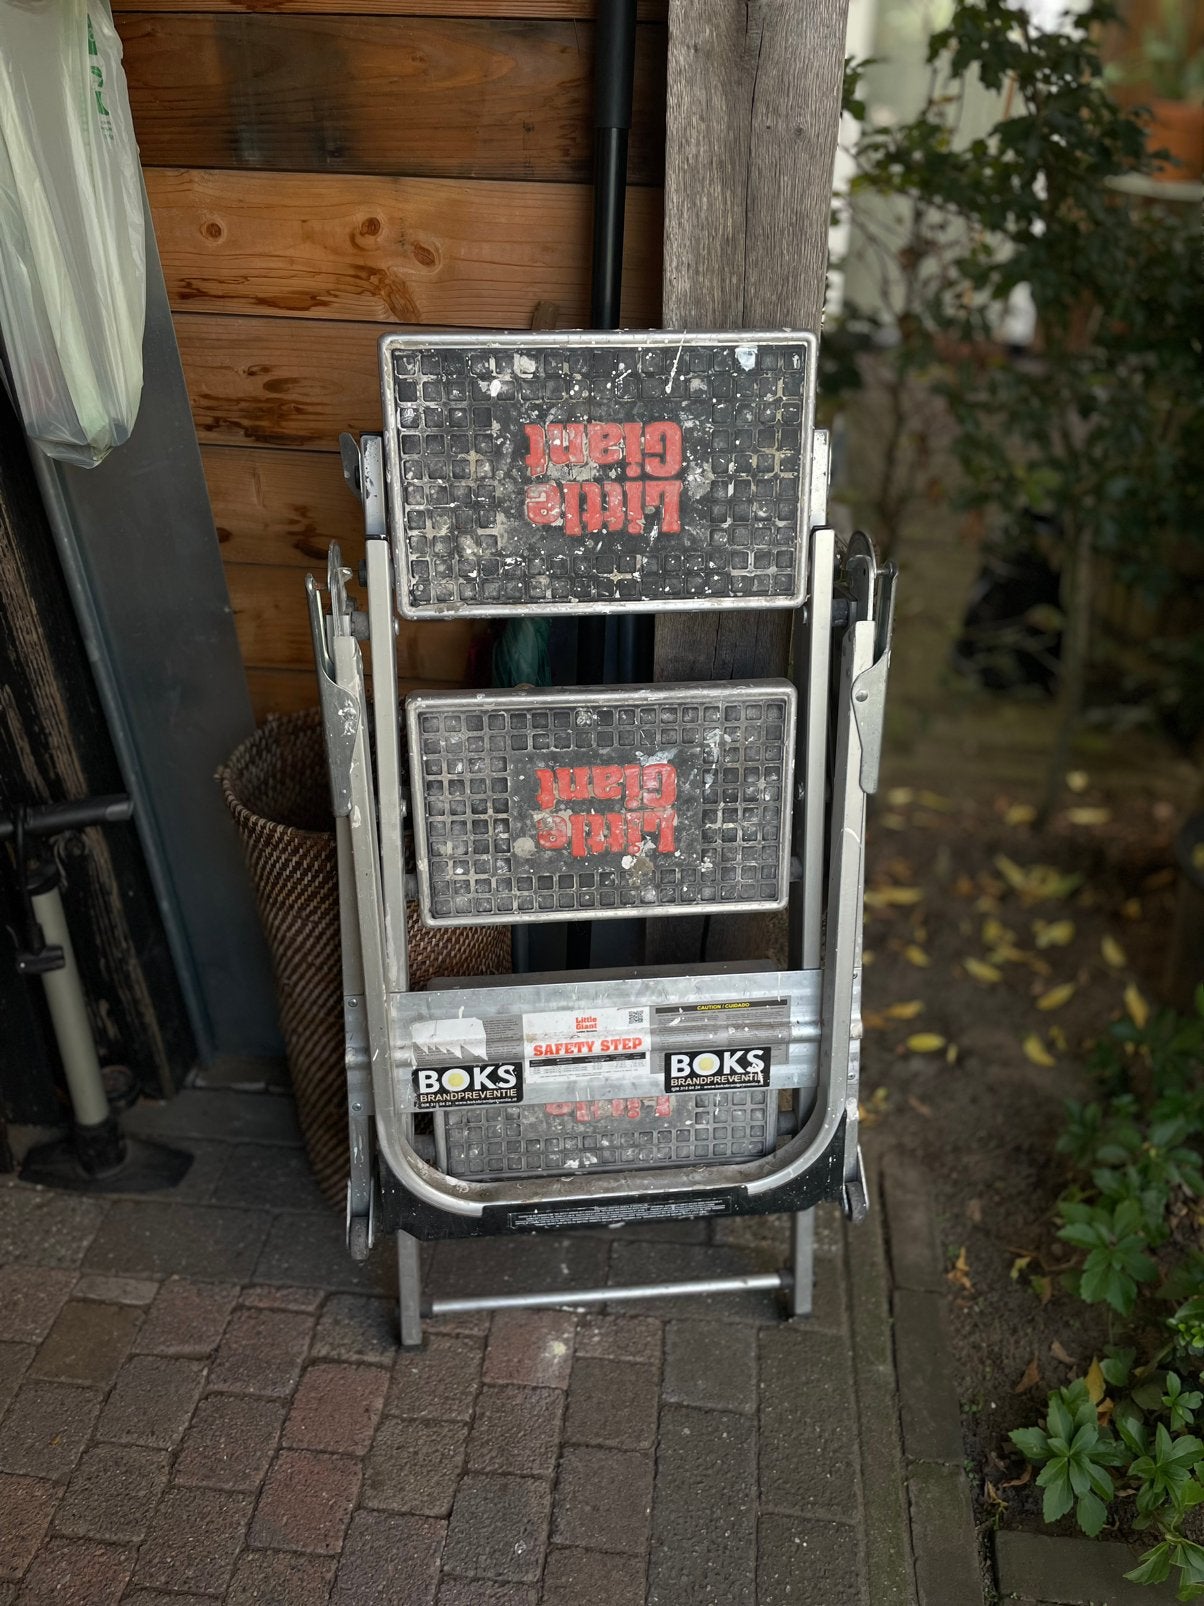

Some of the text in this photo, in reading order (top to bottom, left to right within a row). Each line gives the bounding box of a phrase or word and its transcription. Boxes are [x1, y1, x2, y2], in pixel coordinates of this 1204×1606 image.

[525, 421, 683, 478] Giant
[525, 480, 682, 537] Little
[536, 763, 677, 810] Giant
[536, 808, 677, 858] Little
[697, 1003, 721, 1011] CAUTION
[533, 1037, 643, 1057] SAFETY STEP
[671, 1049, 765, 1077] BOKS
[418, 1064, 517, 1094] BOKS
[420, 1088, 518, 1103] BRANDPREVENTIE
